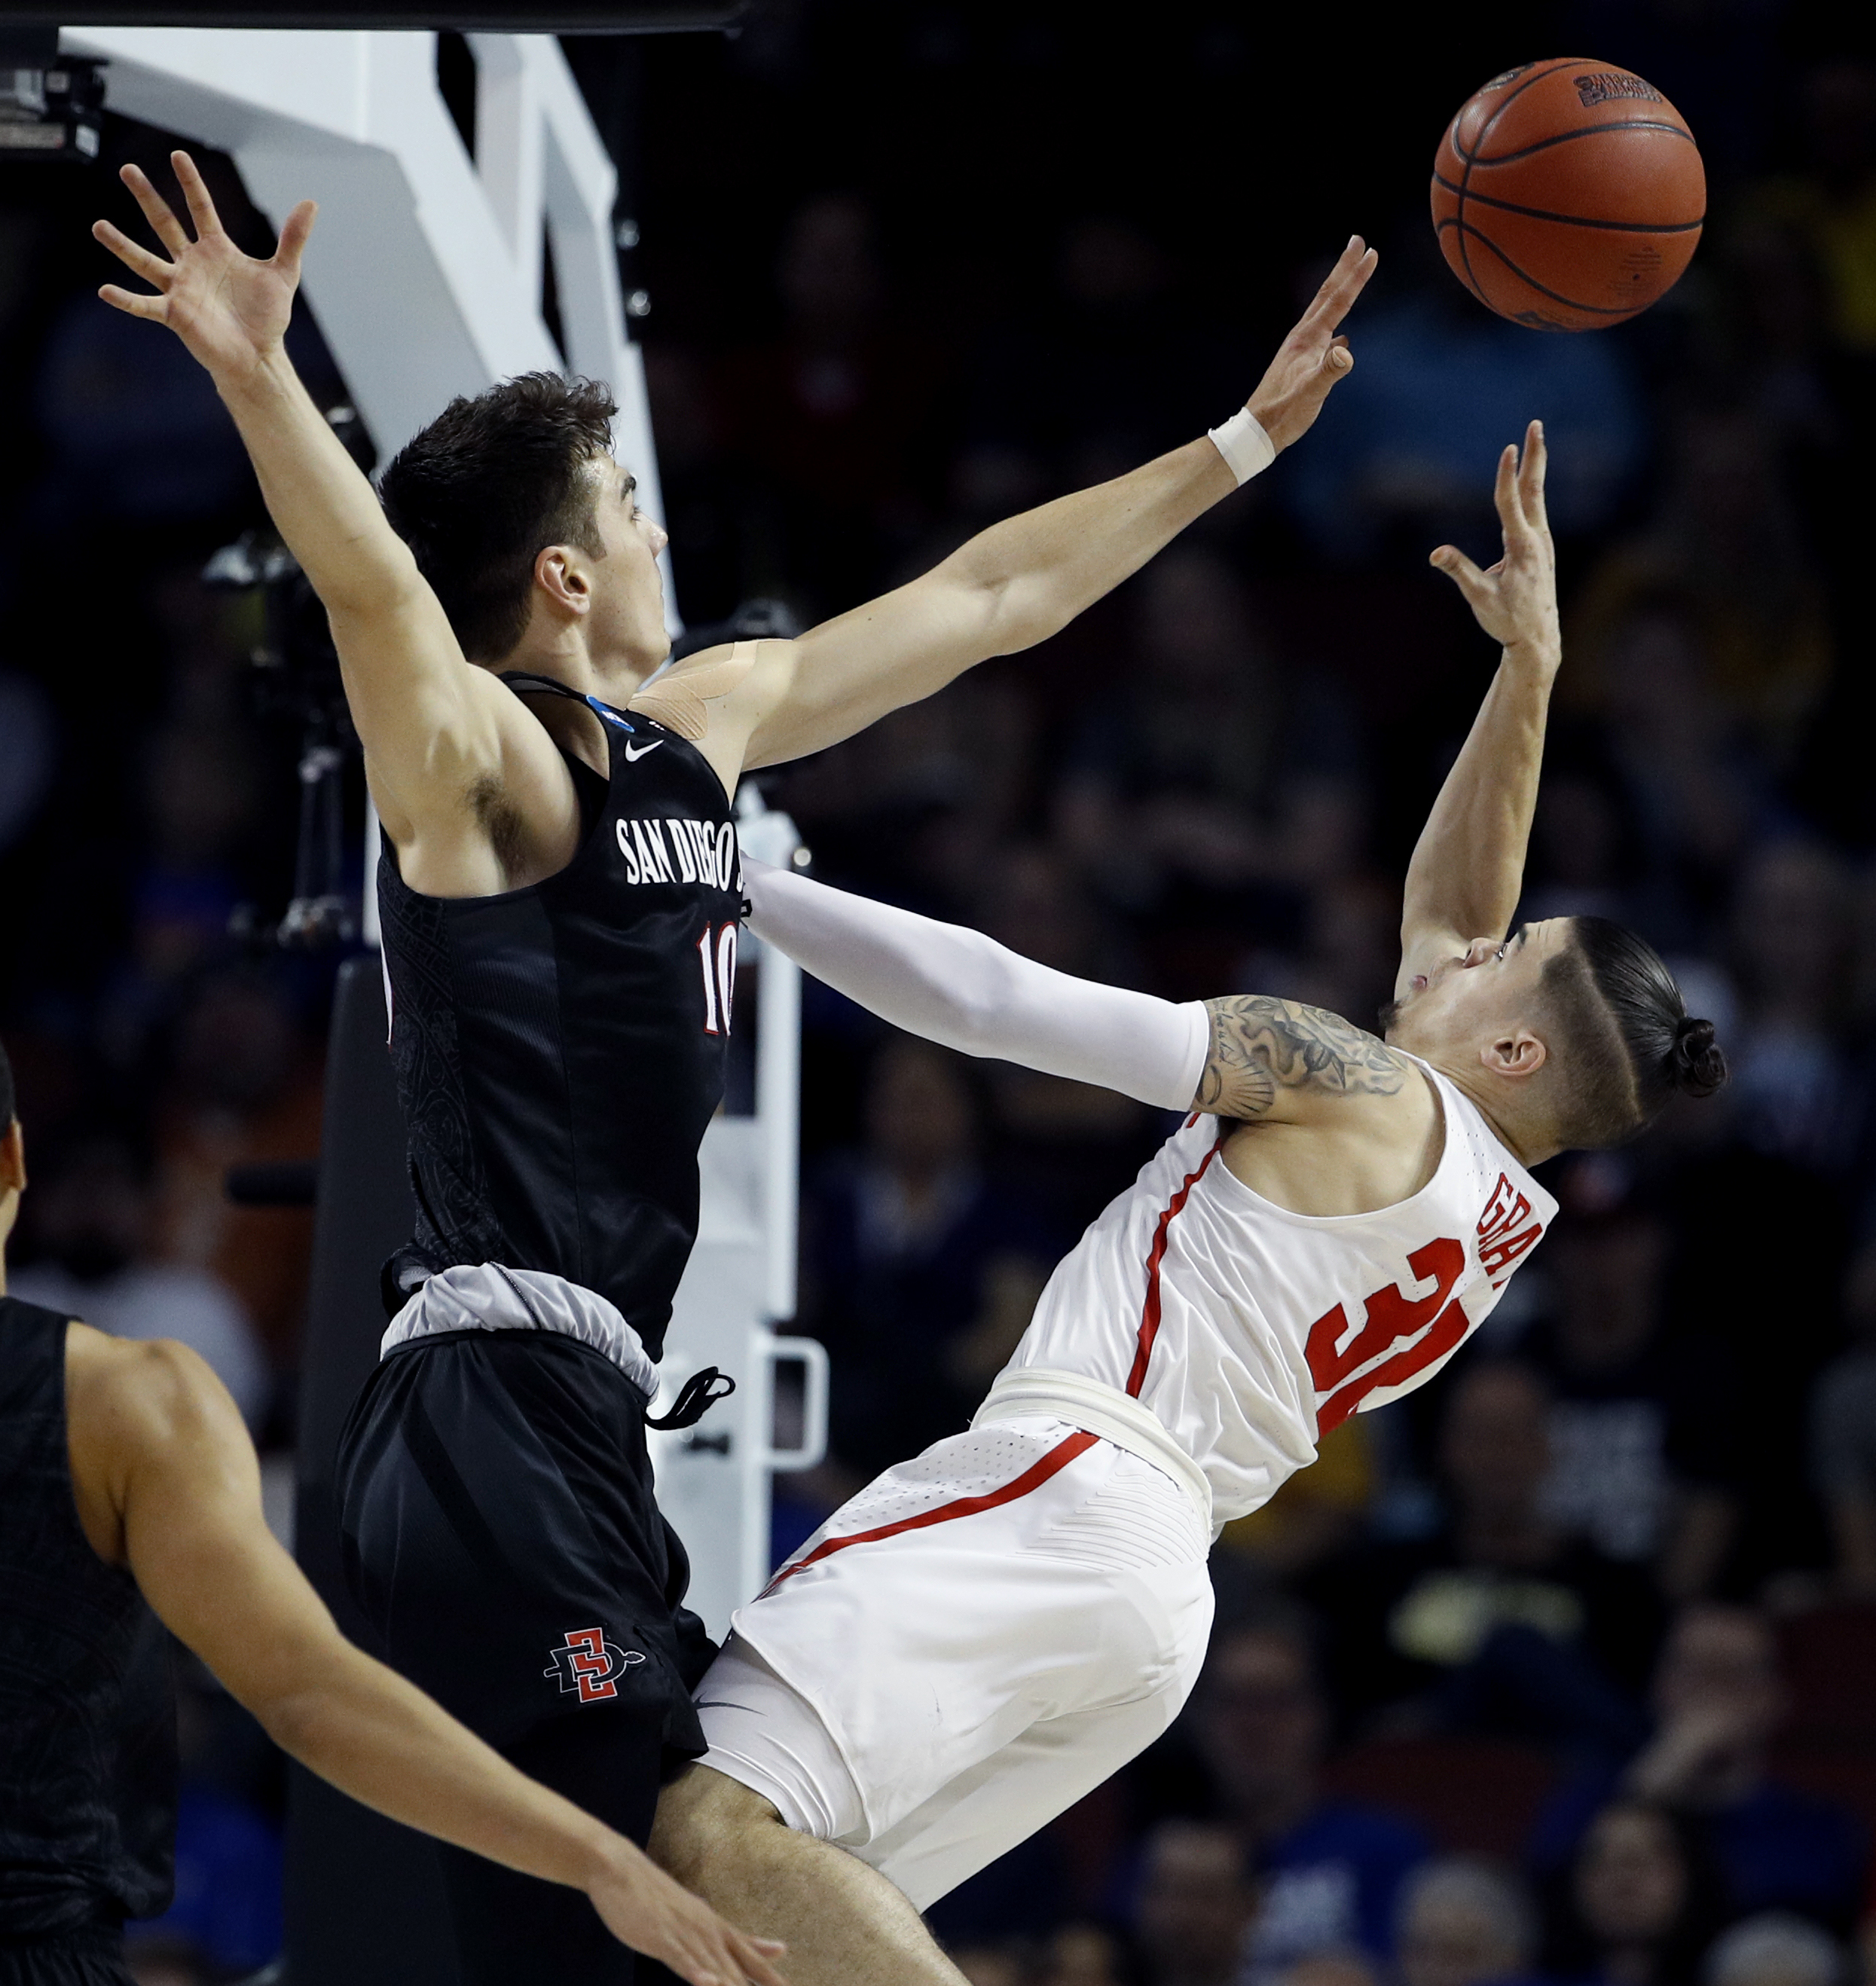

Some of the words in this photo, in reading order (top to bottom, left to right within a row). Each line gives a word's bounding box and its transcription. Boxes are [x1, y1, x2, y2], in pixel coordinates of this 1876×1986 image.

[616, 818, 677, 885] SAN
[665, 818, 735, 892] DIEGO
[695, 921, 738, 1037] 10
[1476, 1172, 1543, 1291] GRA
